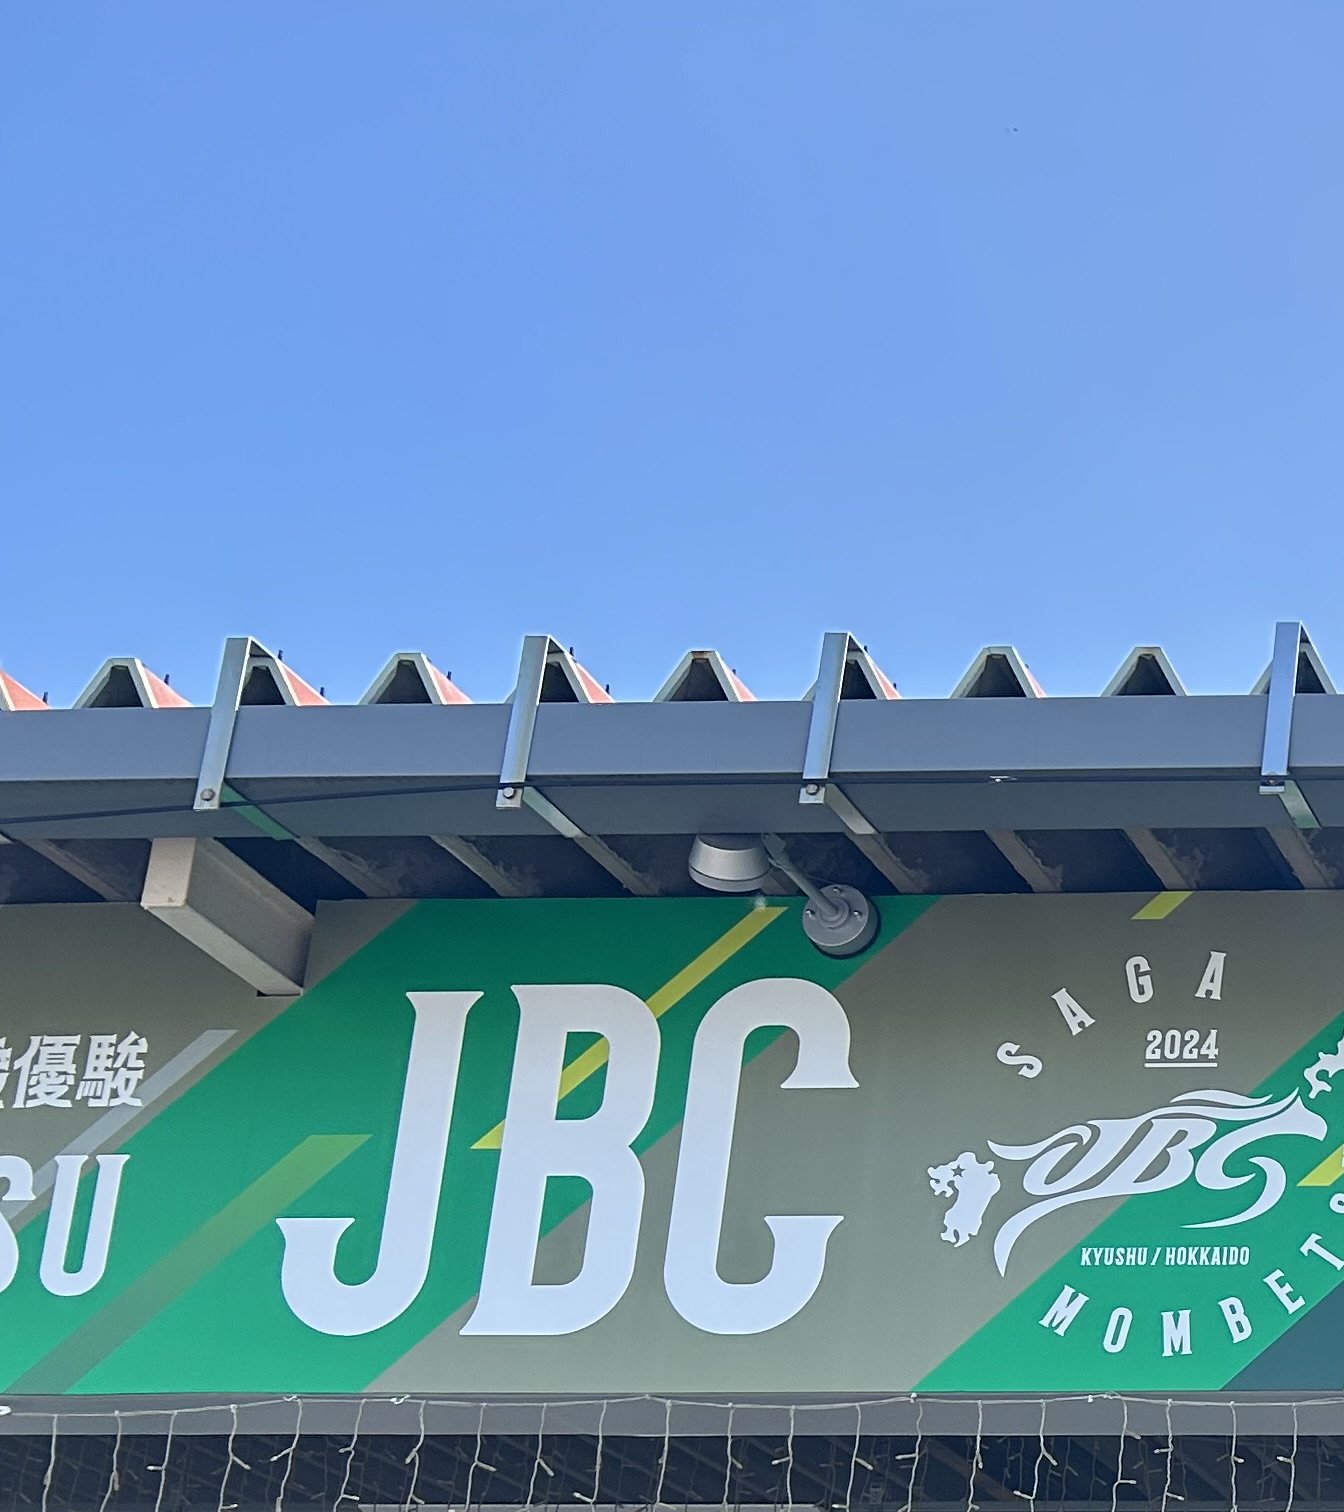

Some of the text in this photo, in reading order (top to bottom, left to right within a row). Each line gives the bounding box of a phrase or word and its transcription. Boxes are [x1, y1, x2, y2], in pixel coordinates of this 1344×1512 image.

[996, 950, 1228, 1079] SAGA
[1144, 1029, 1219, 1060] 2024
[275, 977, 860, 1336] JBC
[1080, 1246, 1148, 1267] KYUSHU
[1164, 1246, 1251, 1266] HOKKAIDO
